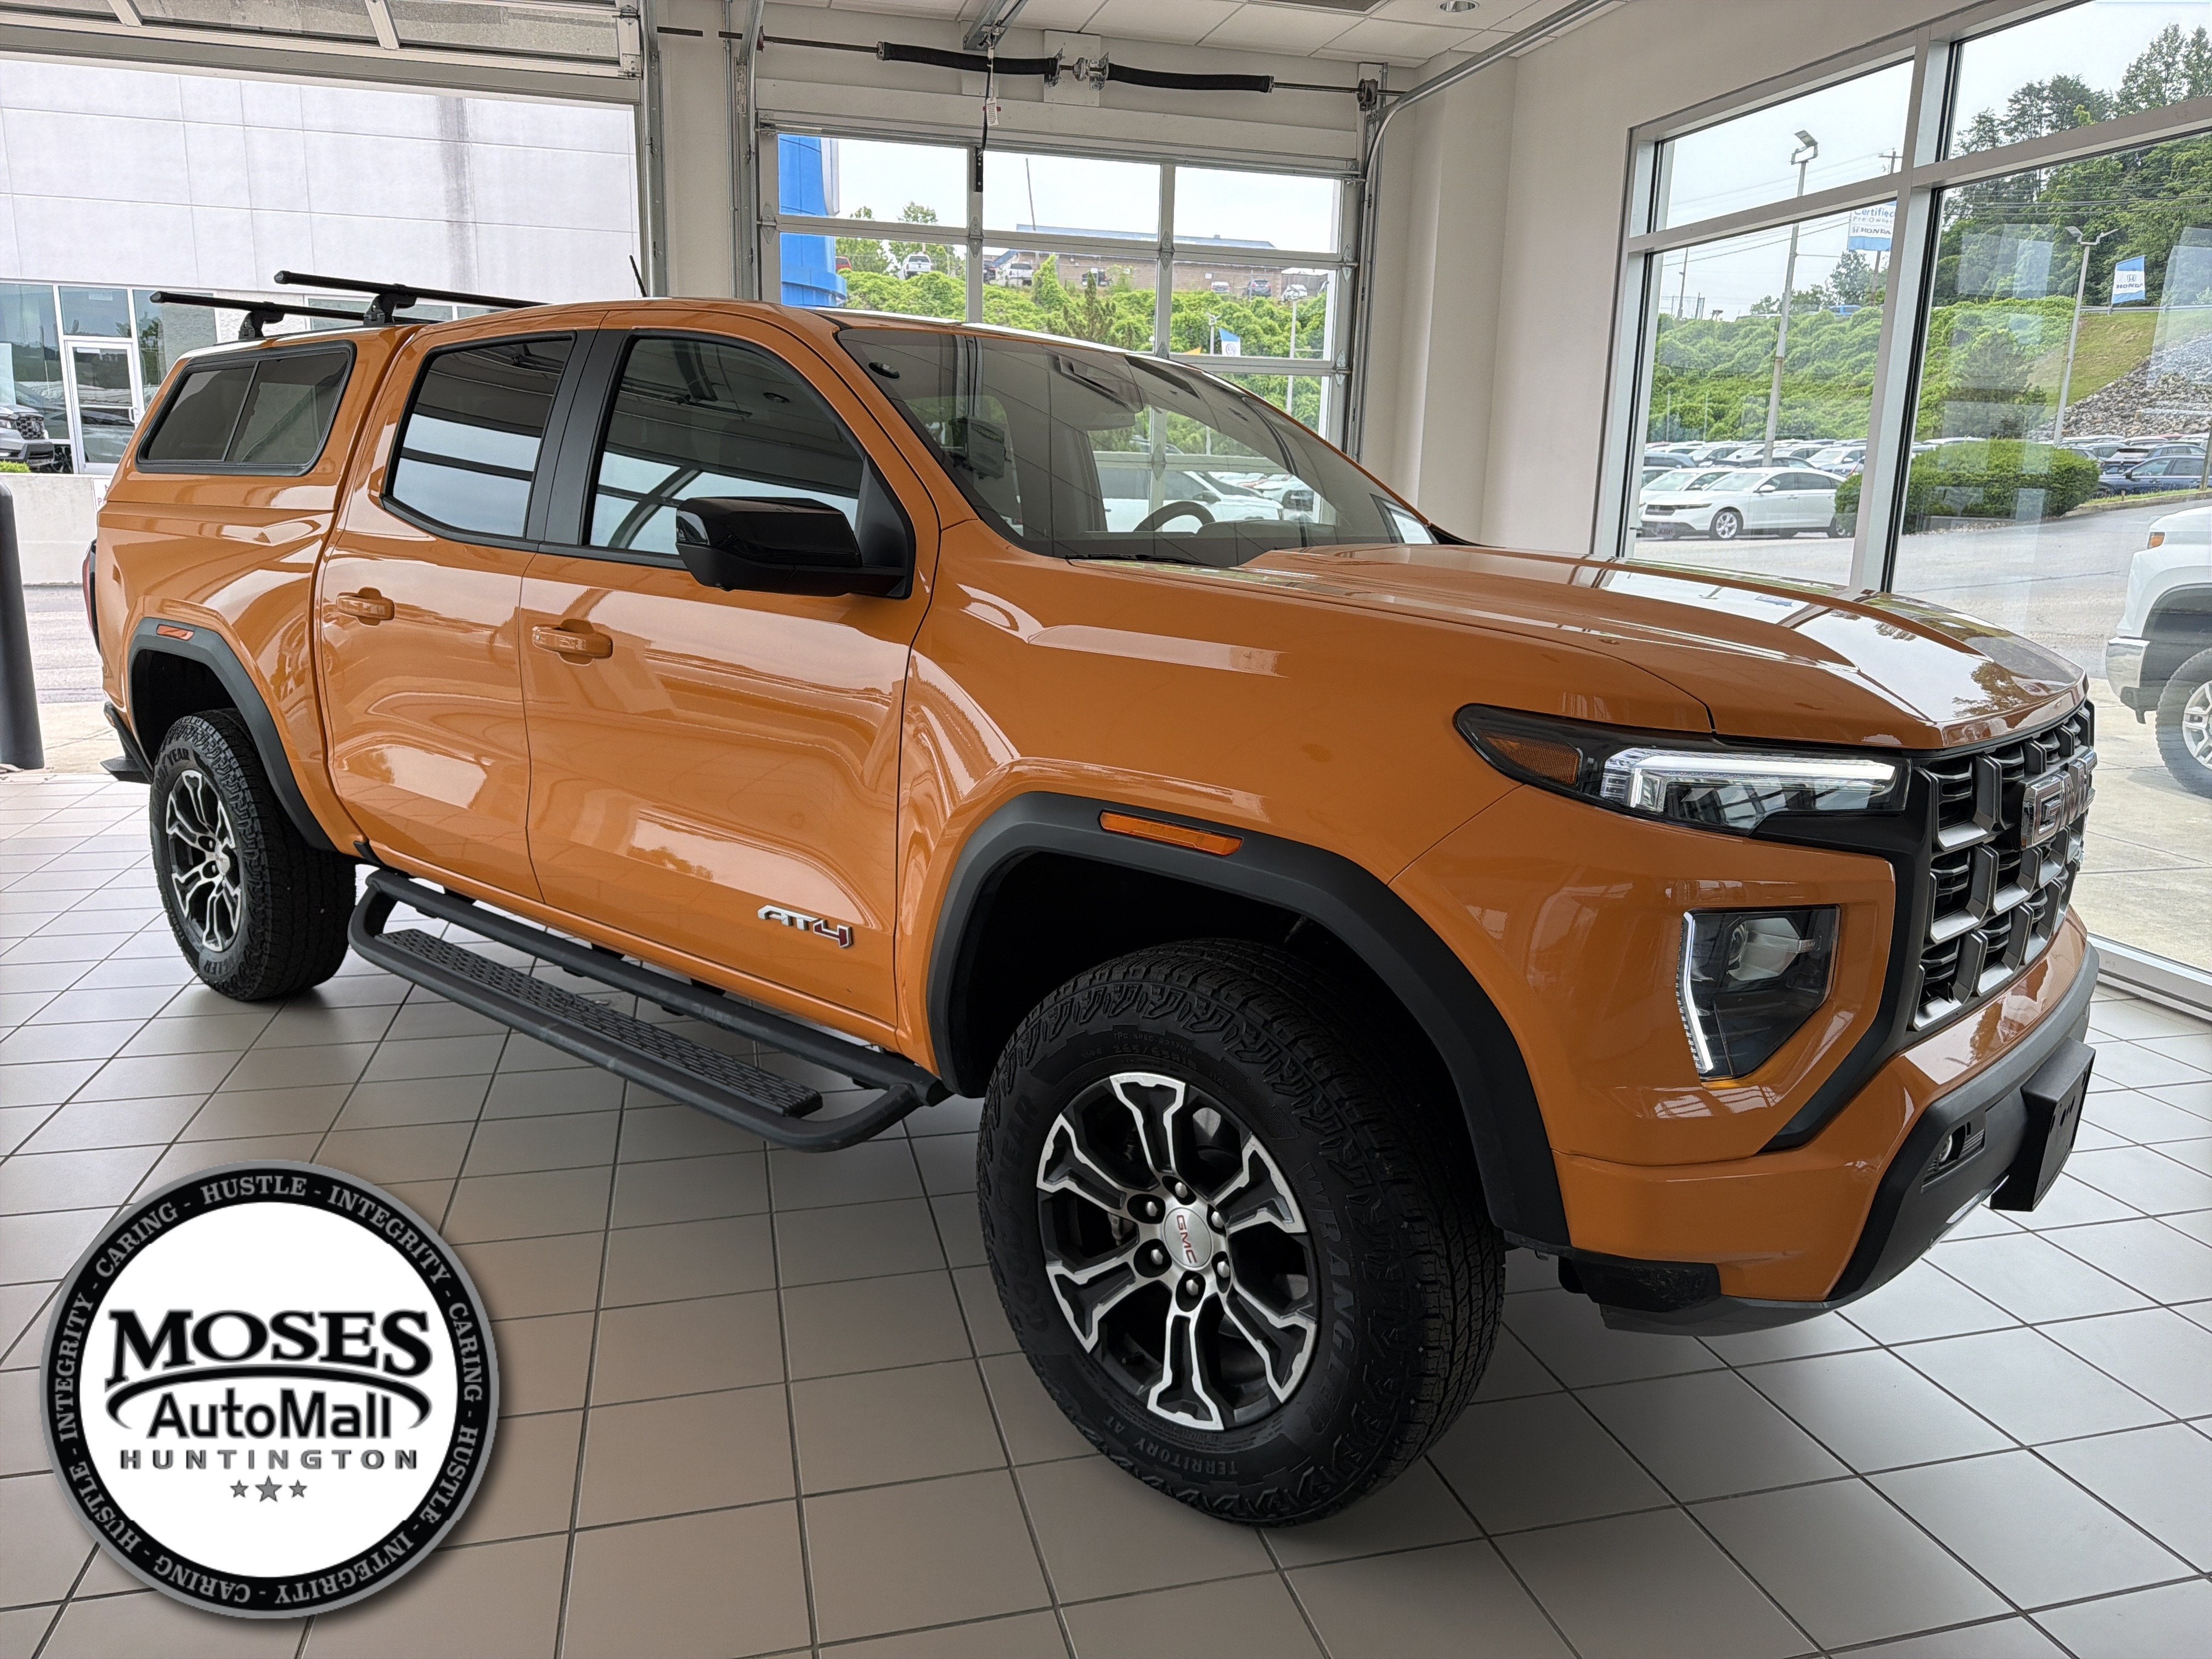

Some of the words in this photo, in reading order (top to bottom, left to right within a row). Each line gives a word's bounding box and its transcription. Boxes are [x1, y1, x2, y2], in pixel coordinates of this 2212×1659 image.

[758, 905, 854, 949] AT4
[1177, 1215, 1197, 1264] GMC
[1103, 1415, 1126, 1434] AT
[1133, 1437, 1238, 1475] TERRITORY
